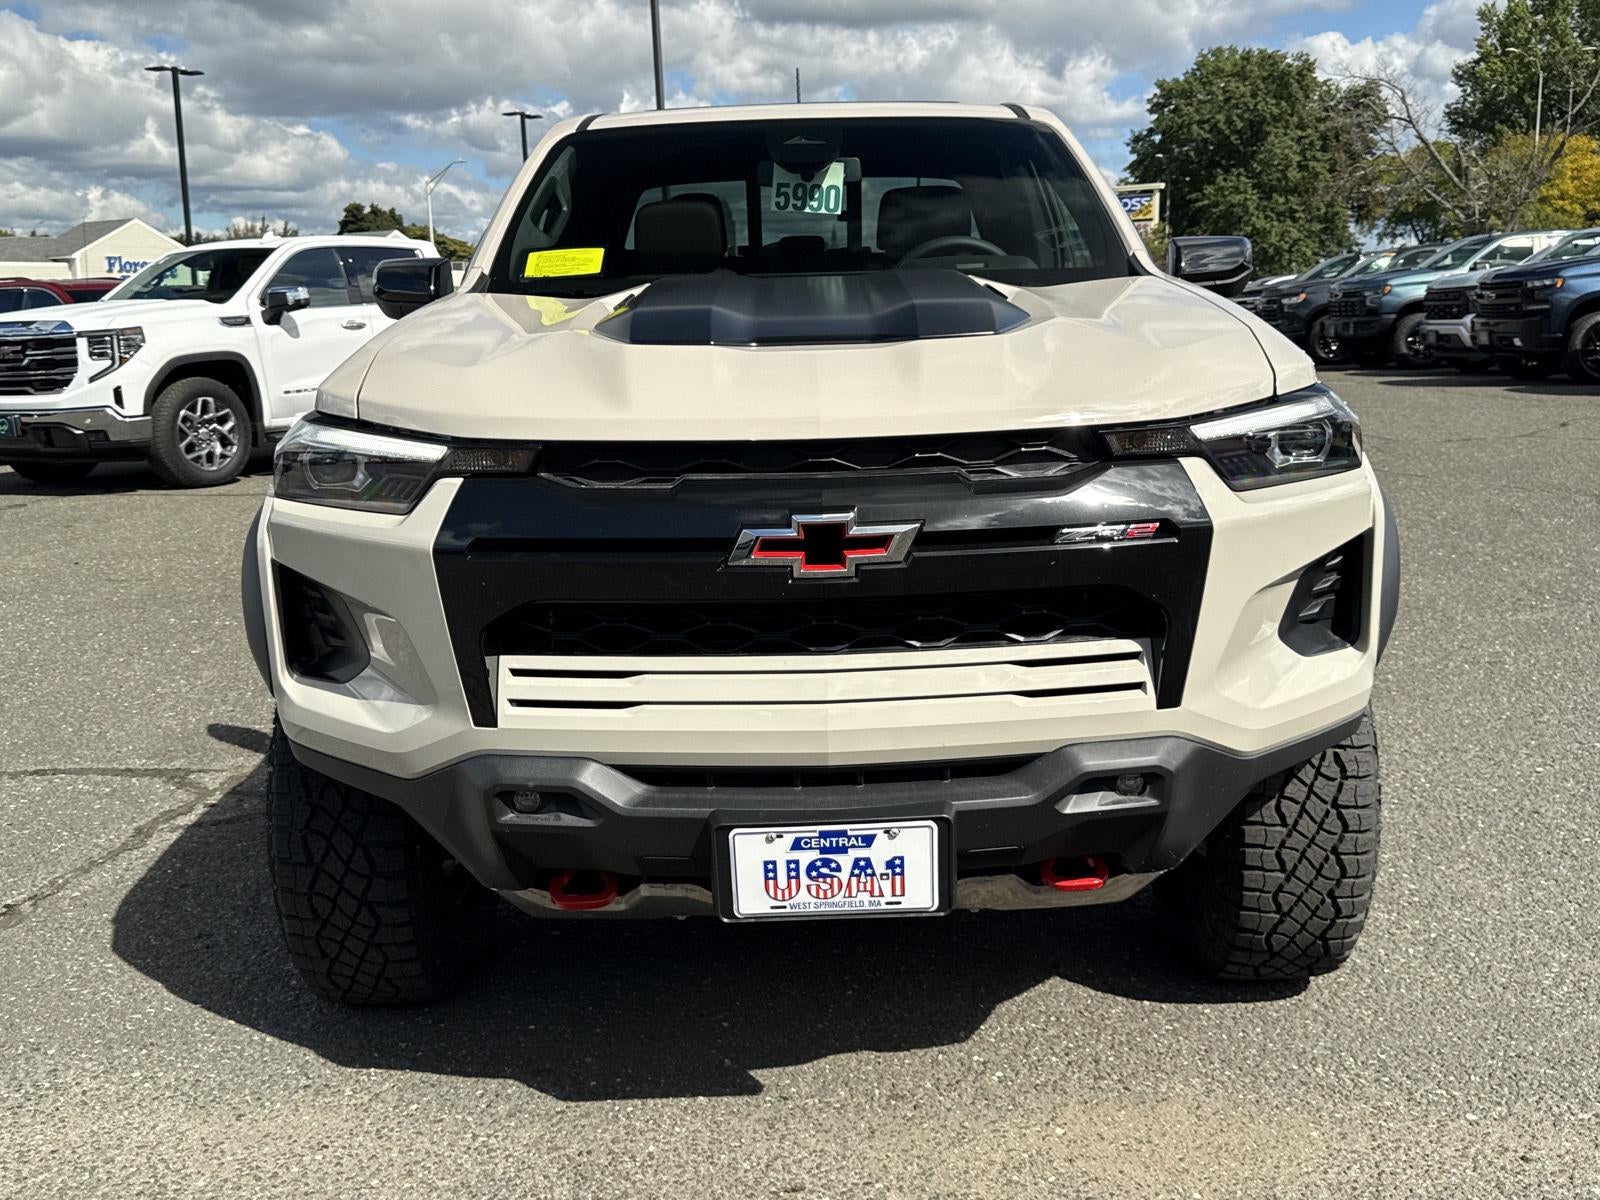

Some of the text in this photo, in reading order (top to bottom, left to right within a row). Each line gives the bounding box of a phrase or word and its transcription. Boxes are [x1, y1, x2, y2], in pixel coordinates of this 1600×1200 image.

[775, 182, 841, 213] 5990
[800, 836, 867, 849] CENTRAL
[763, 855, 906, 902] USA-1
[789, 900, 882, 911] WEST SPRINGFIELD, MA
